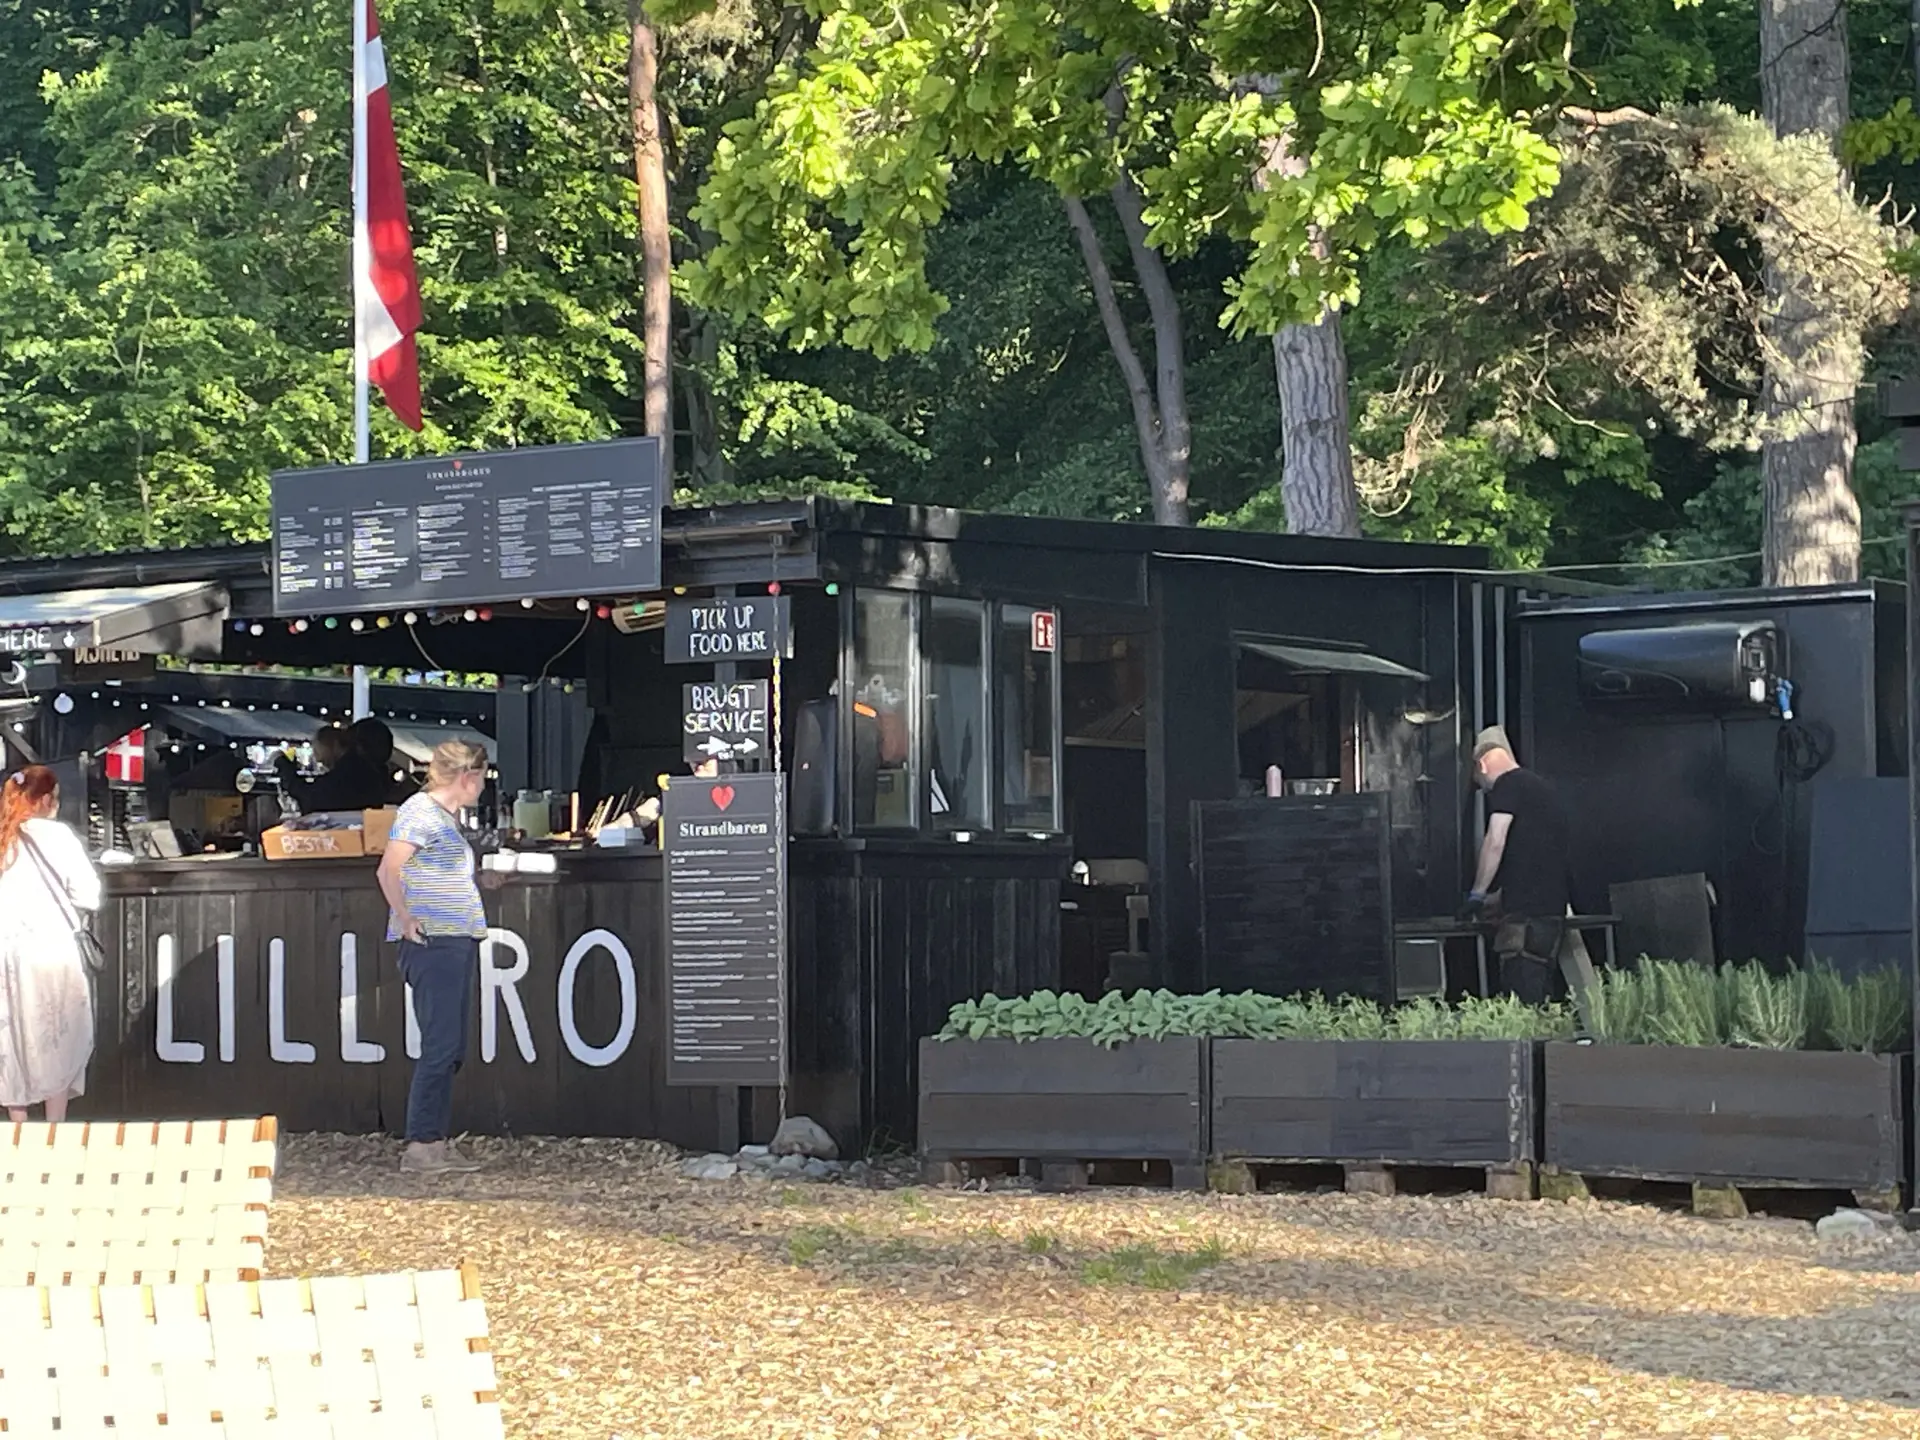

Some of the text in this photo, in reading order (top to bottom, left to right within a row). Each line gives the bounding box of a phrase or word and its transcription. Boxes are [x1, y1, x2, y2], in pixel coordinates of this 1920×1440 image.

[691, 605, 754, 631] PICK UP
[690, 631, 767, 658] FOOD HERE
[692, 684, 757, 711] BRUGT
[684, 710, 764, 734] SERVICE
[679, 821, 768, 837] Strandbaren
[281, 835, 340, 854] BESTIK
[155, 927, 637, 1067] LILLRO
